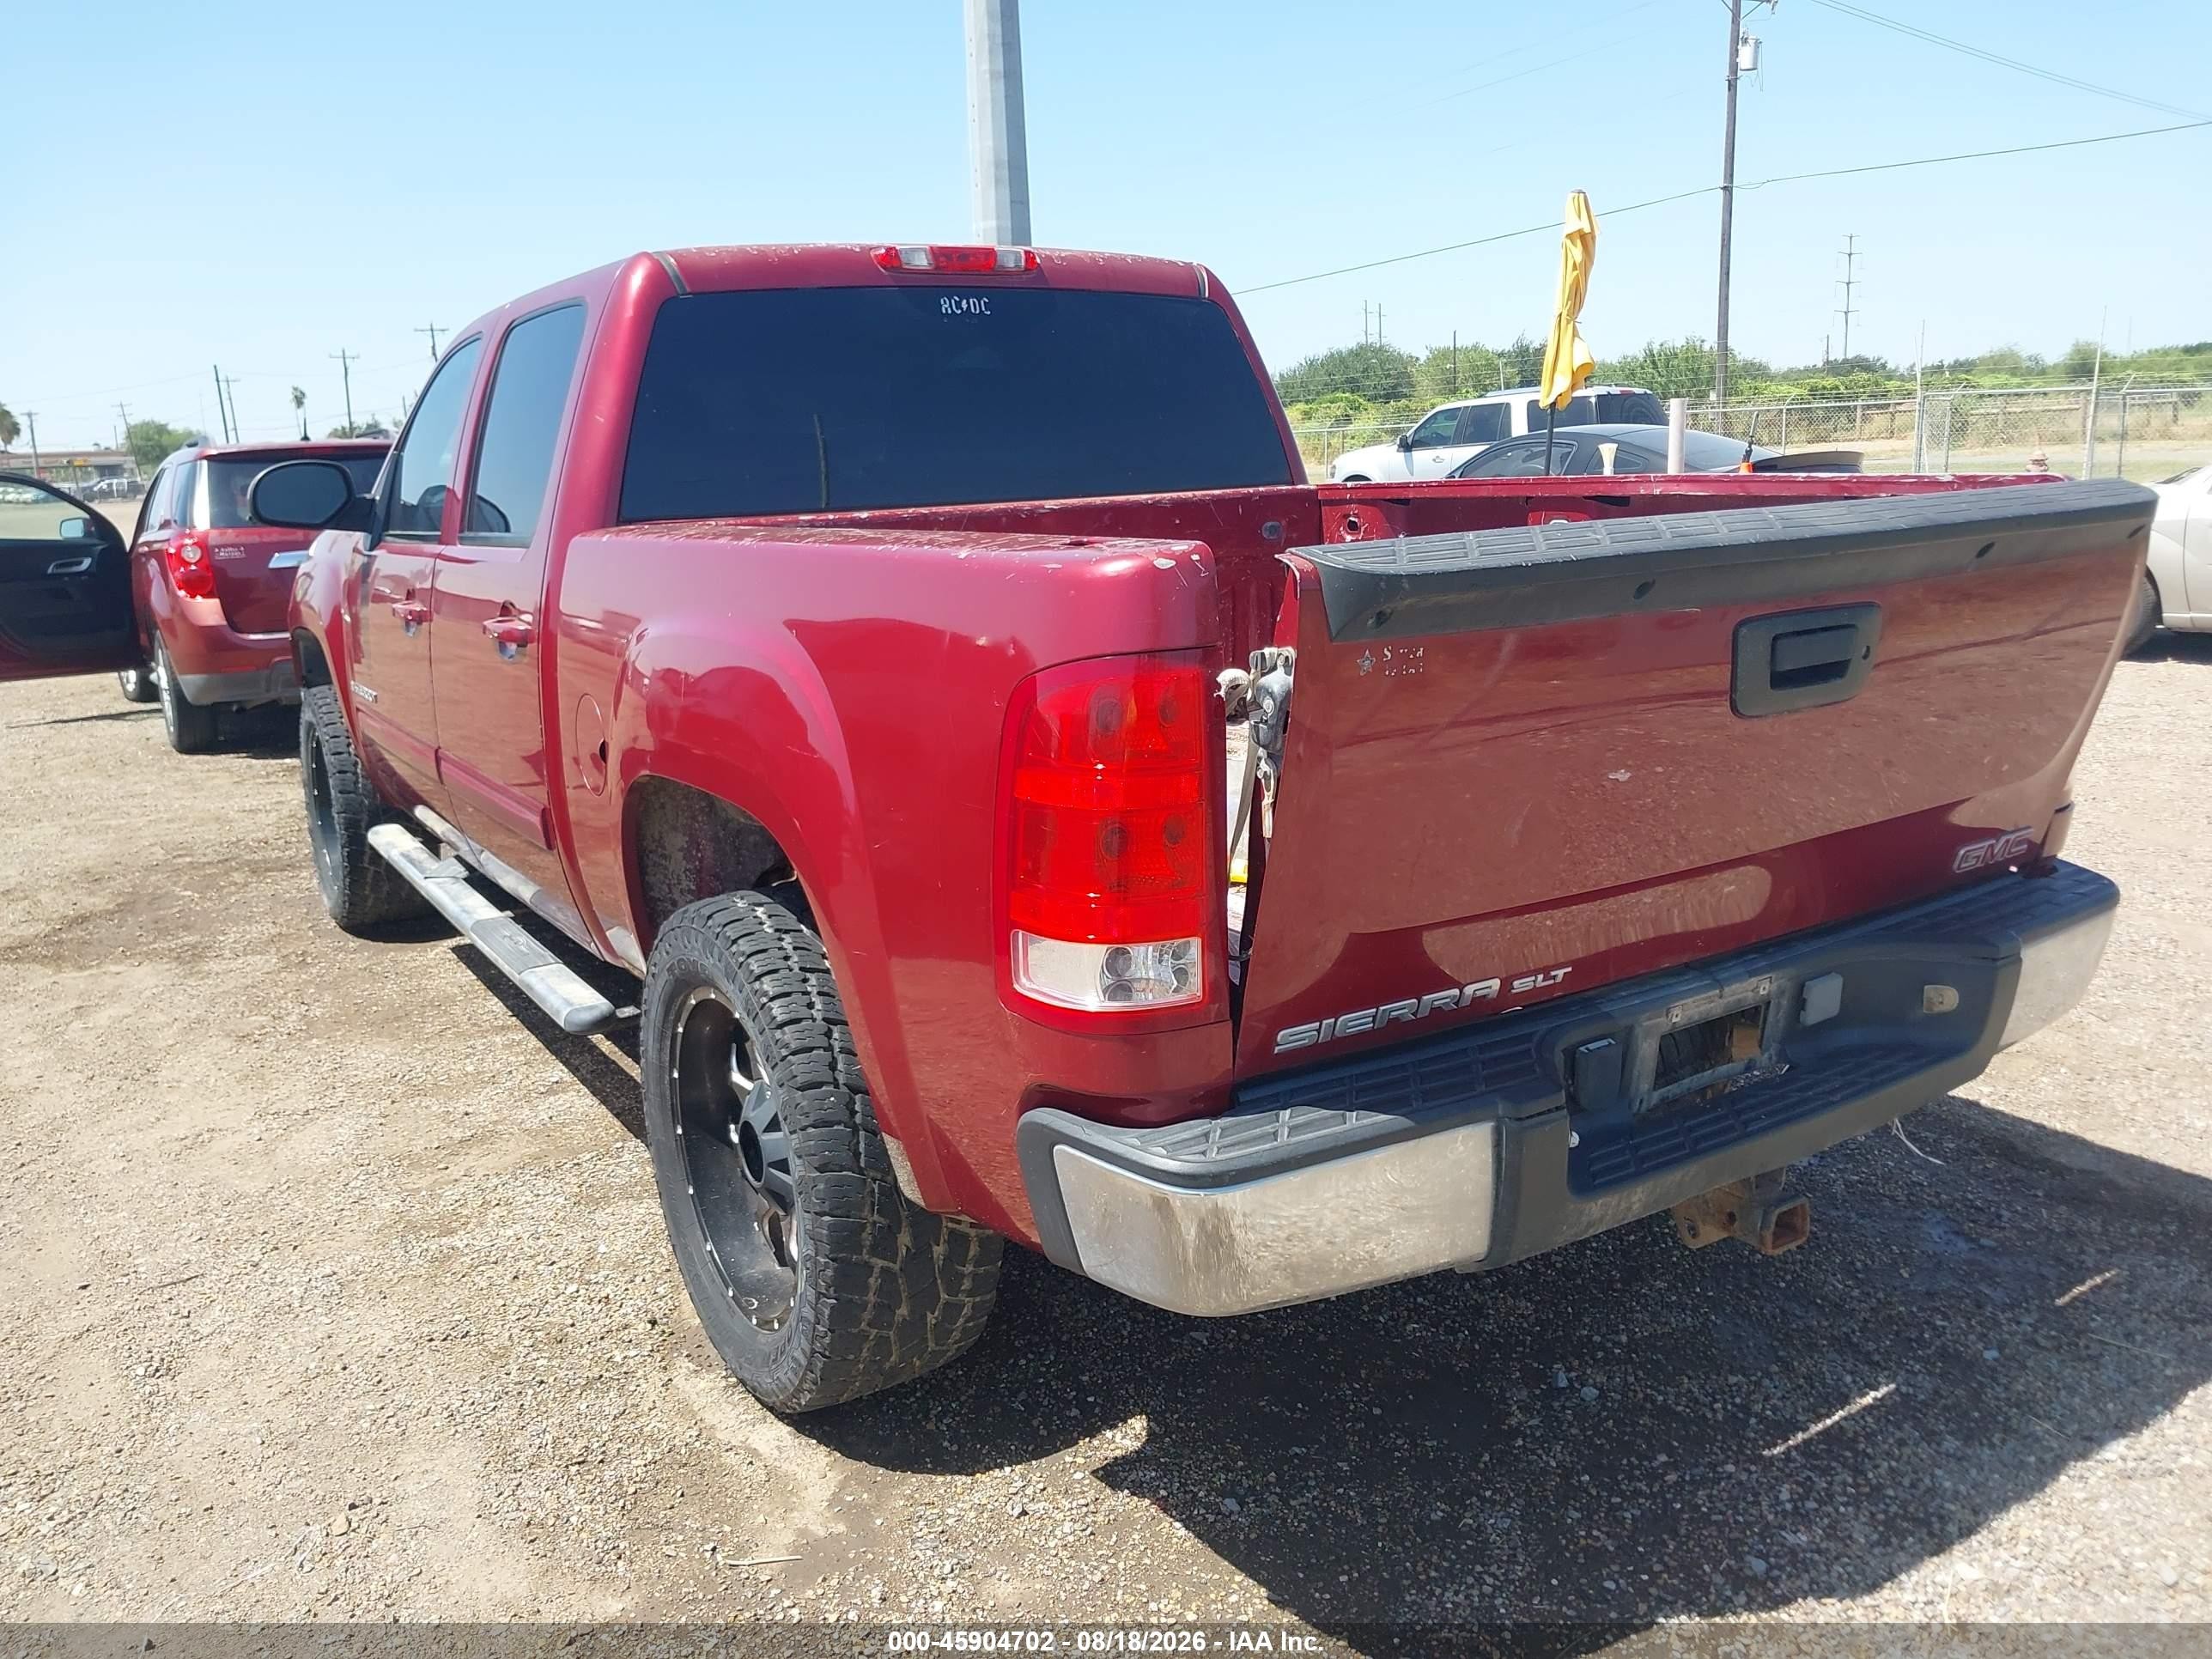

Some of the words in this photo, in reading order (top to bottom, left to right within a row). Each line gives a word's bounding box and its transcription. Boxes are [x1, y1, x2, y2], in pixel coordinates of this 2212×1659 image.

[1953, 826, 2033, 872] GMC
[1274, 977, 1501, 1054] SIERRA
[1510, 967, 1572, 994] SLT
